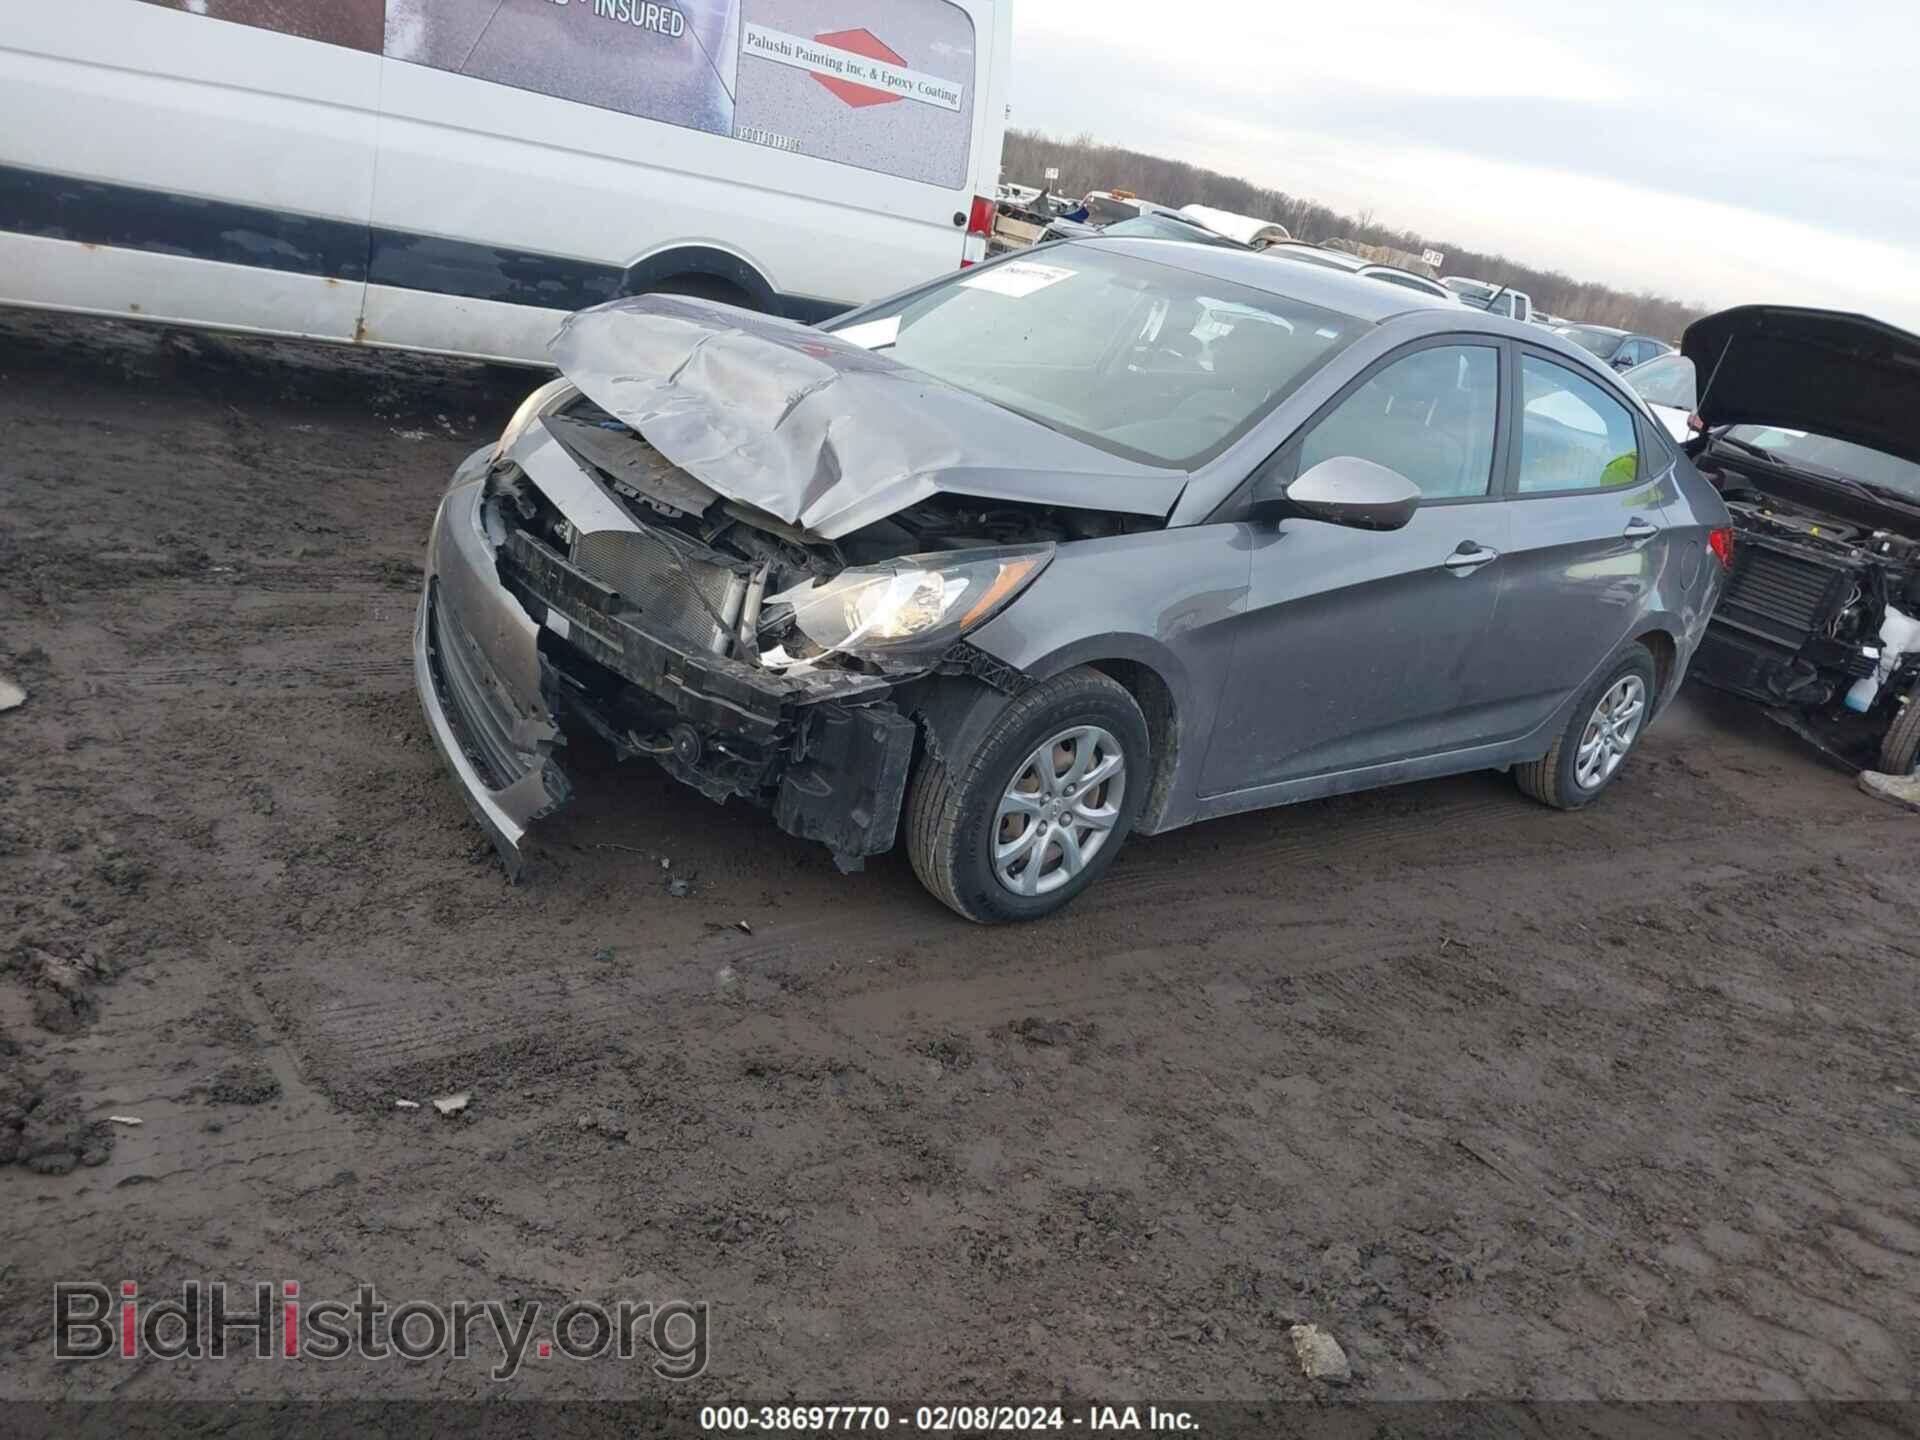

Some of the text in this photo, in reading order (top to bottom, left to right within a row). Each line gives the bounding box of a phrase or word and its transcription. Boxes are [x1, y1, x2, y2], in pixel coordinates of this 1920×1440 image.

[594, 0, 686, 37] INSURED
[747, 32, 792, 57] Palushi
[796, 45, 843, 72] Painting
[869, 68, 878, 80] &
[881, 71, 914, 92] Epoxy
[918, 82, 958, 105] Coating
